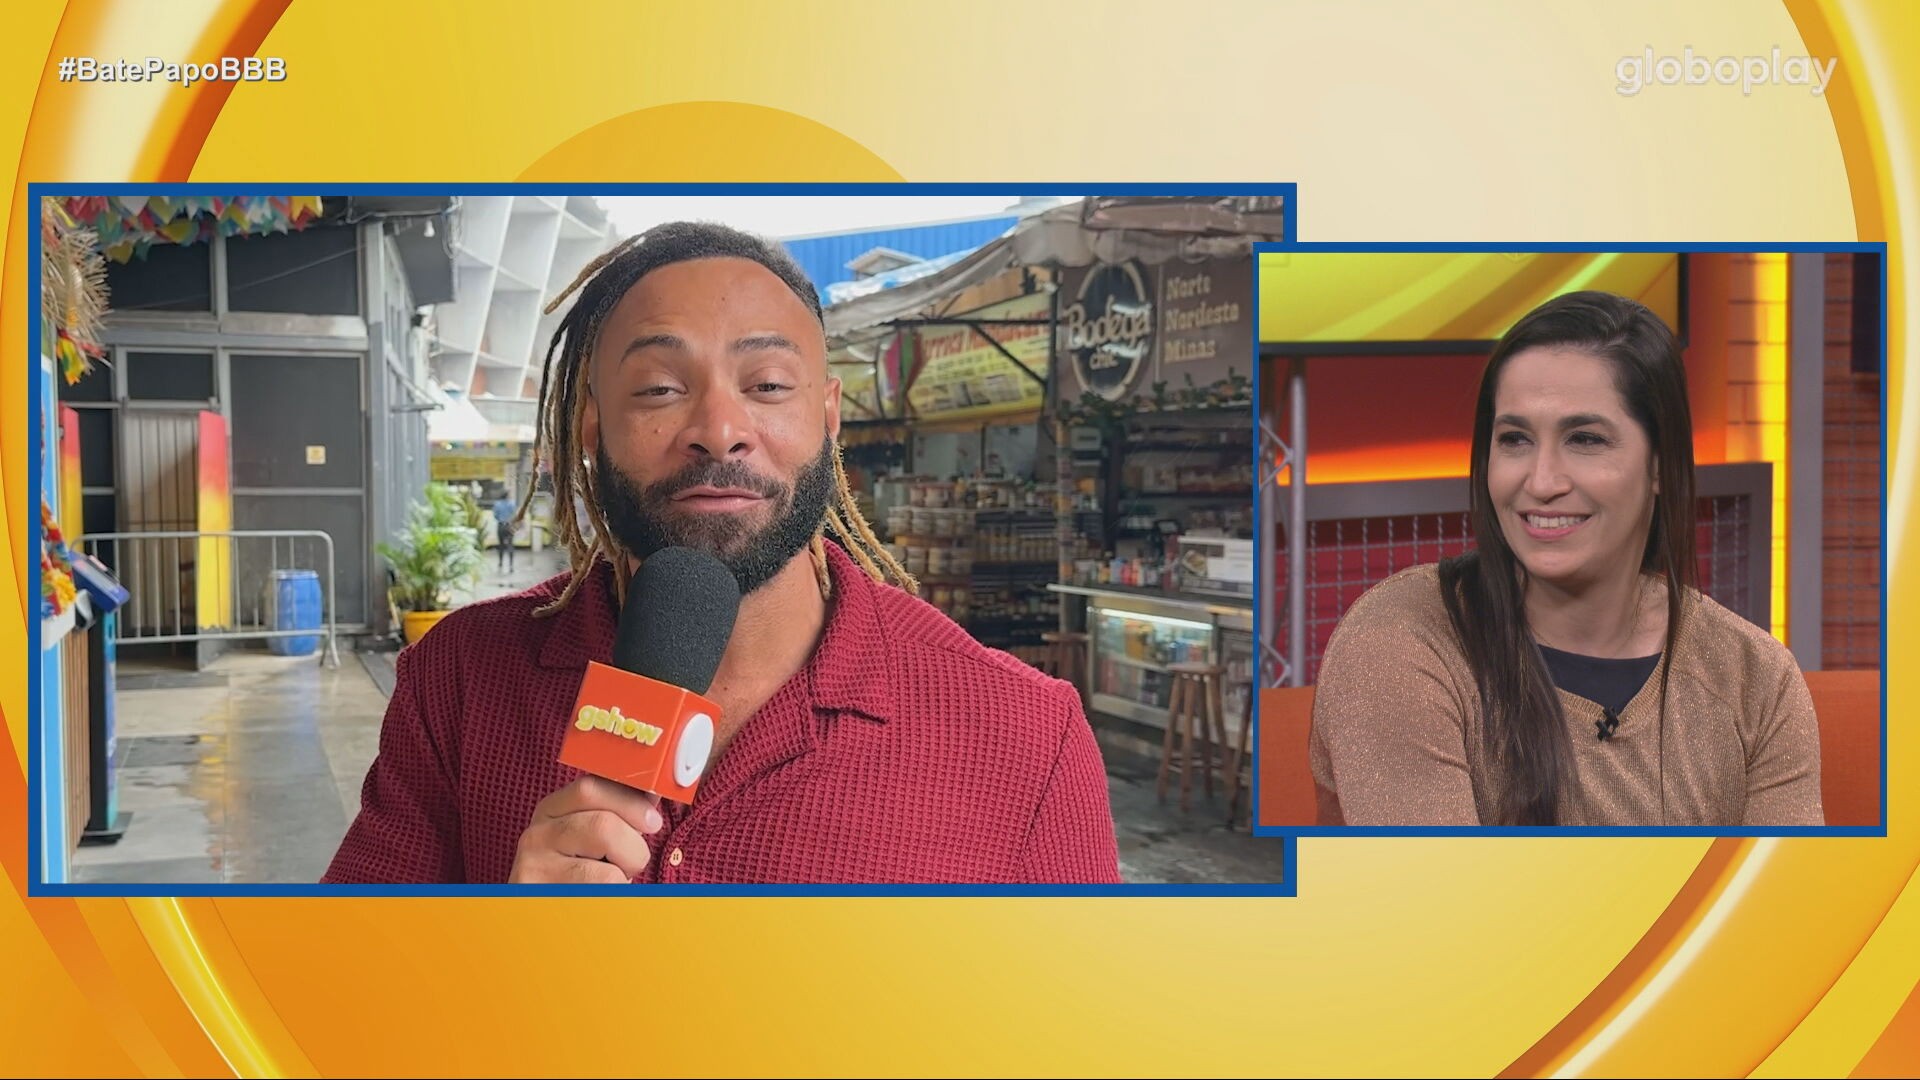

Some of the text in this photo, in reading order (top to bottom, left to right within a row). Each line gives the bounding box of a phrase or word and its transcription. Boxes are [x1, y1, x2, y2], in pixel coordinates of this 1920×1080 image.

[1166, 274, 1211, 301] Norte
[1063, 294, 1151, 348] Bodega
[1165, 302, 1240, 332] Nordeste
[1163, 339, 1216, 364] Minas
[575, 705, 663, 746] gshow
